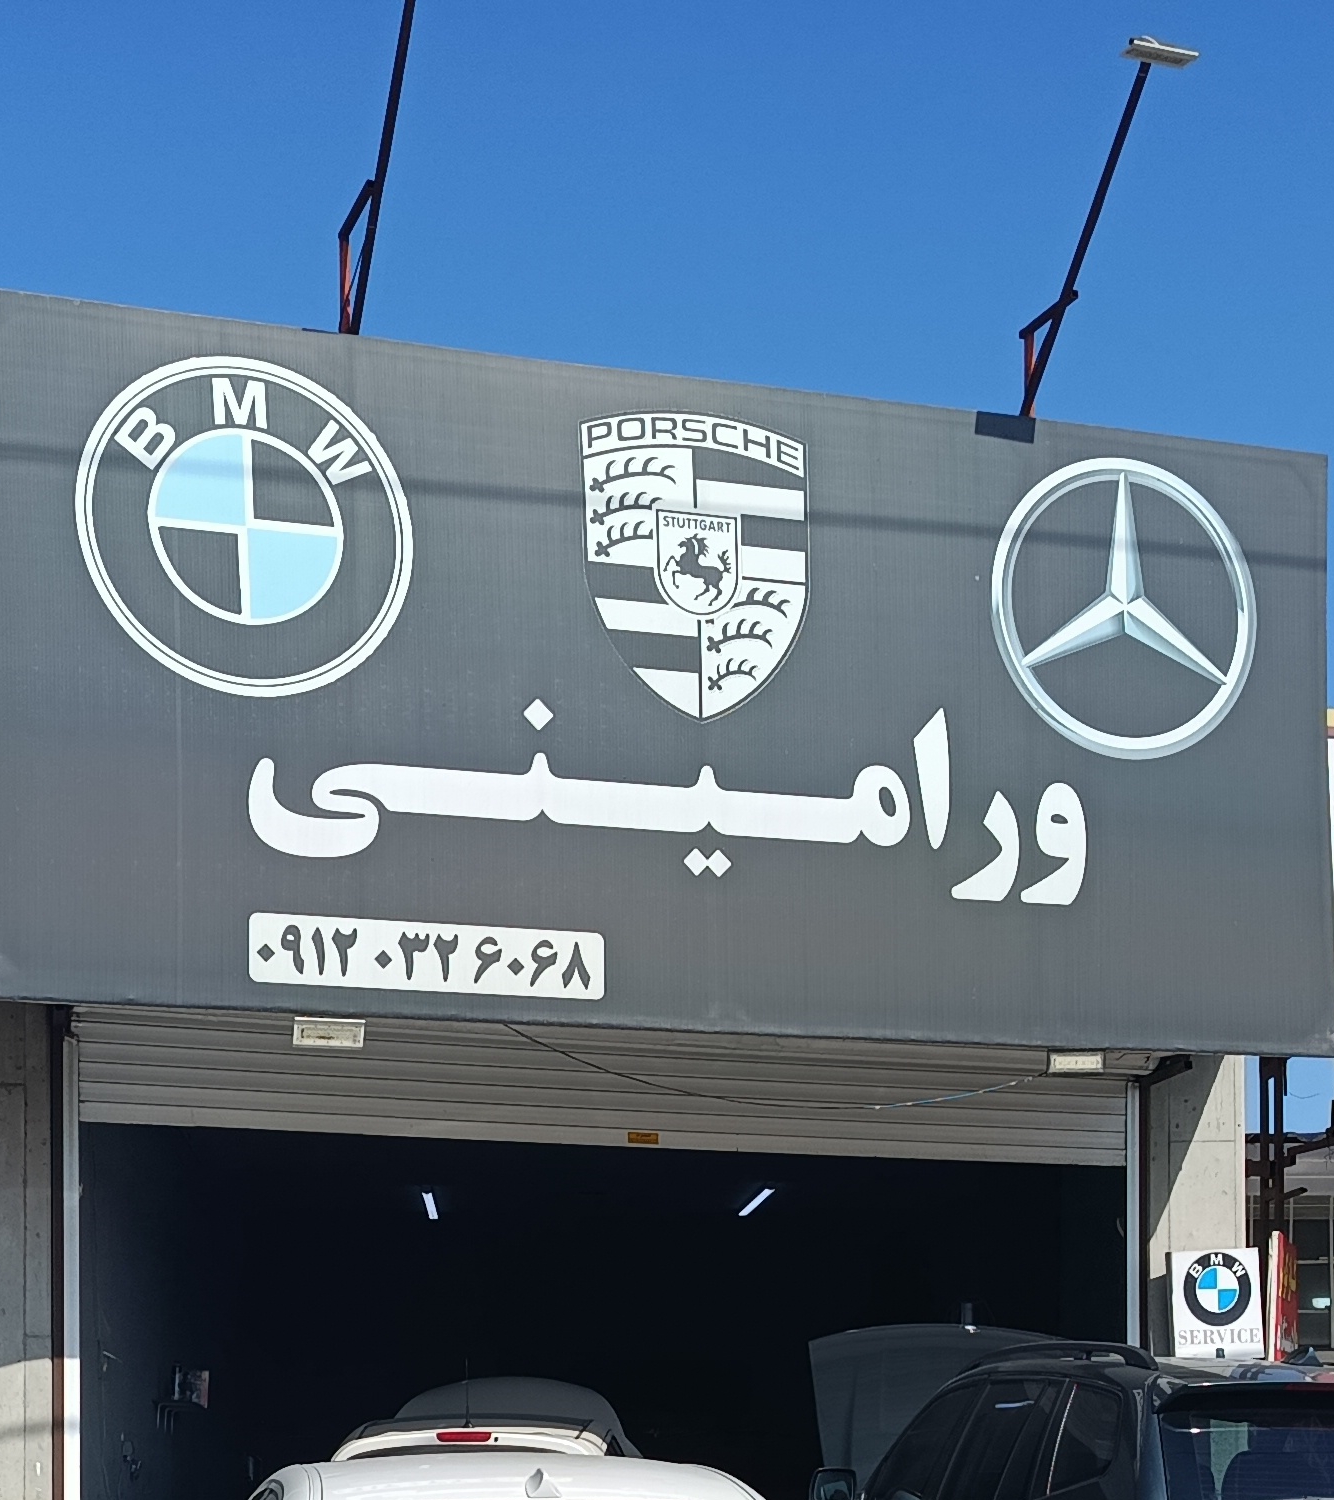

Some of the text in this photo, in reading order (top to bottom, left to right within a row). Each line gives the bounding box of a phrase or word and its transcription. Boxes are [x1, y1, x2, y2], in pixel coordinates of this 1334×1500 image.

[114, 377, 373, 486] BMW
[586, 416, 800, 471] PORSCHE
[662, 515, 732, 534] STUTTGART
[248, 698, 1087, 906] ورامینی
[257, 924, 591, 990] ۰۹۱۲ ۰۳۲ ۶۰۶۸
[1189, 1254, 1246, 1279] BMW
[1178, 1327, 1261, 1346] SERVICE
